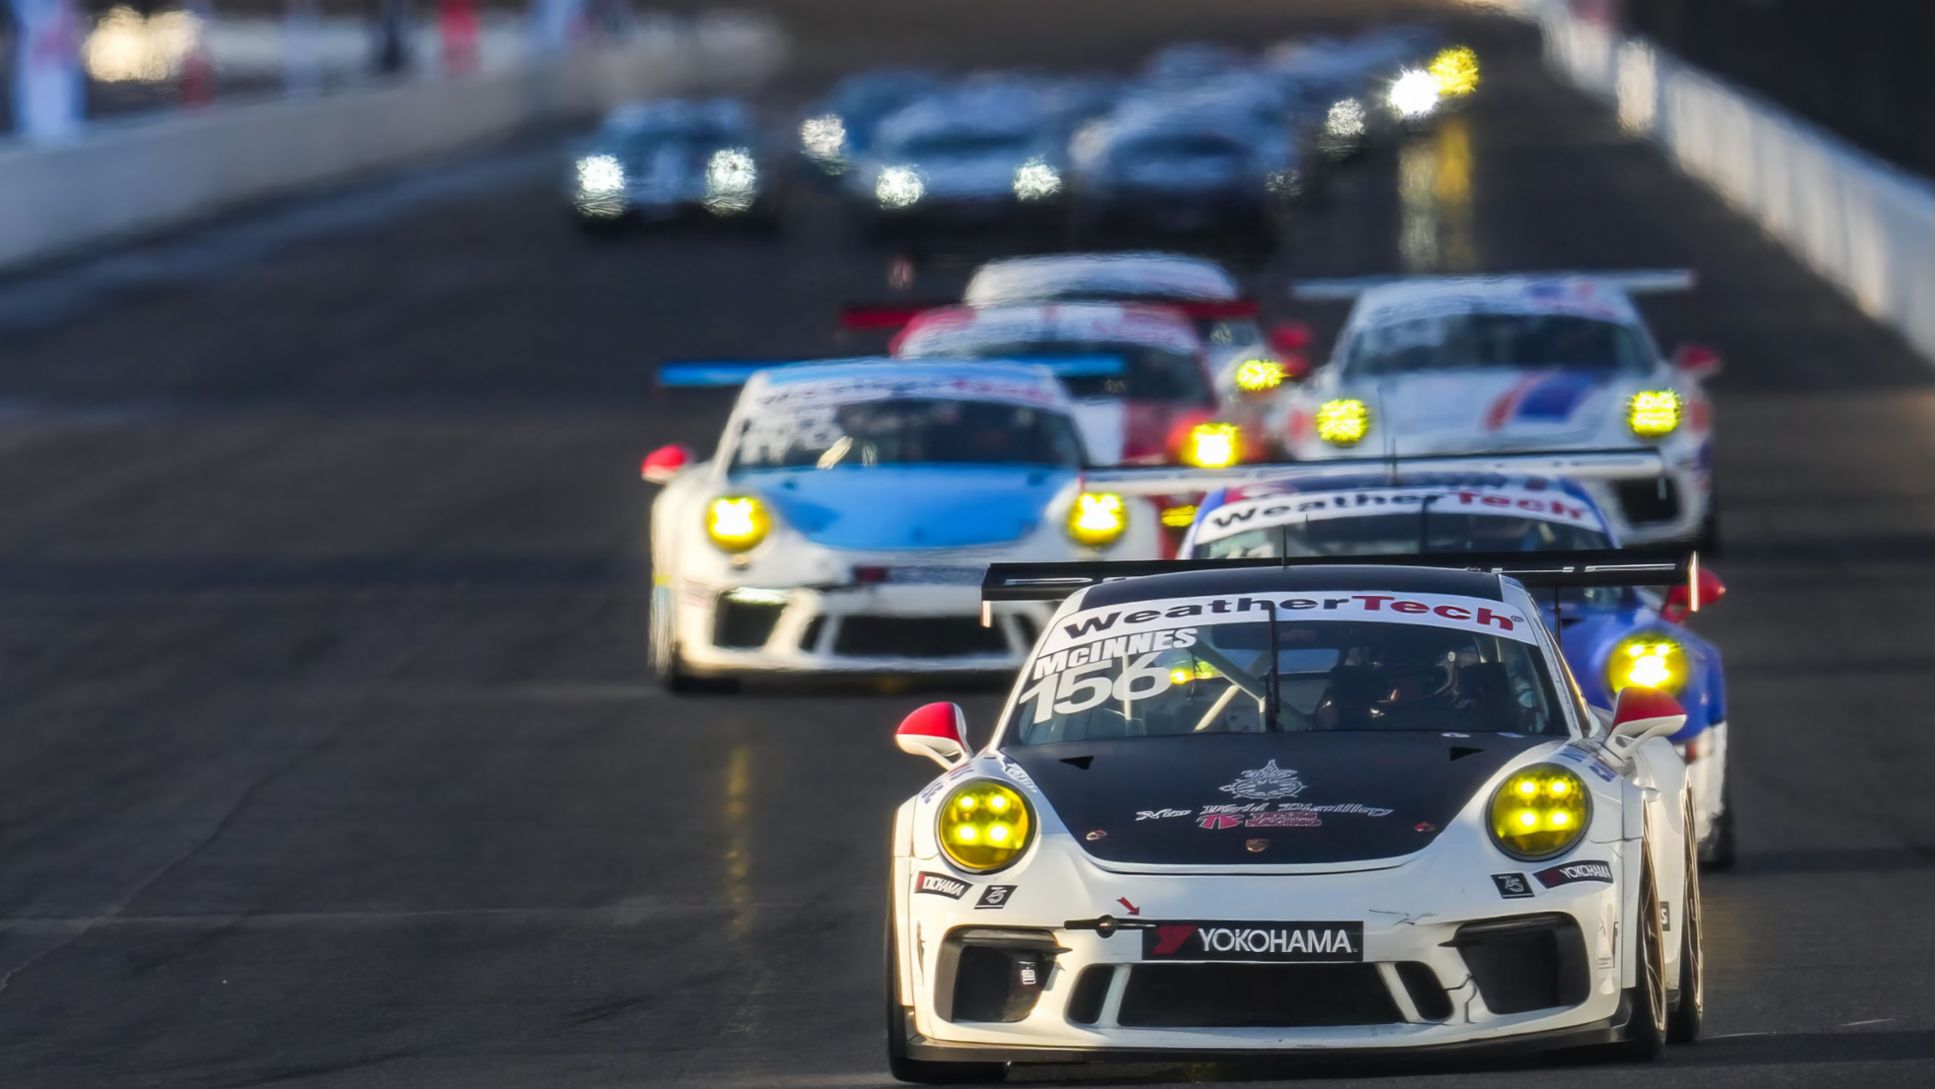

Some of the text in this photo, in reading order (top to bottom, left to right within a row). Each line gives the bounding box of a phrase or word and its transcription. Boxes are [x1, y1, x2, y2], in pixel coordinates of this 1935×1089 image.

[1214, 490, 1584, 528] WeatherTech
[1063, 595, 1515, 639] WeatherTech
[1018, 651, 1172, 724] 156
[1559, 863, 1613, 880] YOKOHAMA
[1198, 927, 1353, 952] YOKOHAMA
